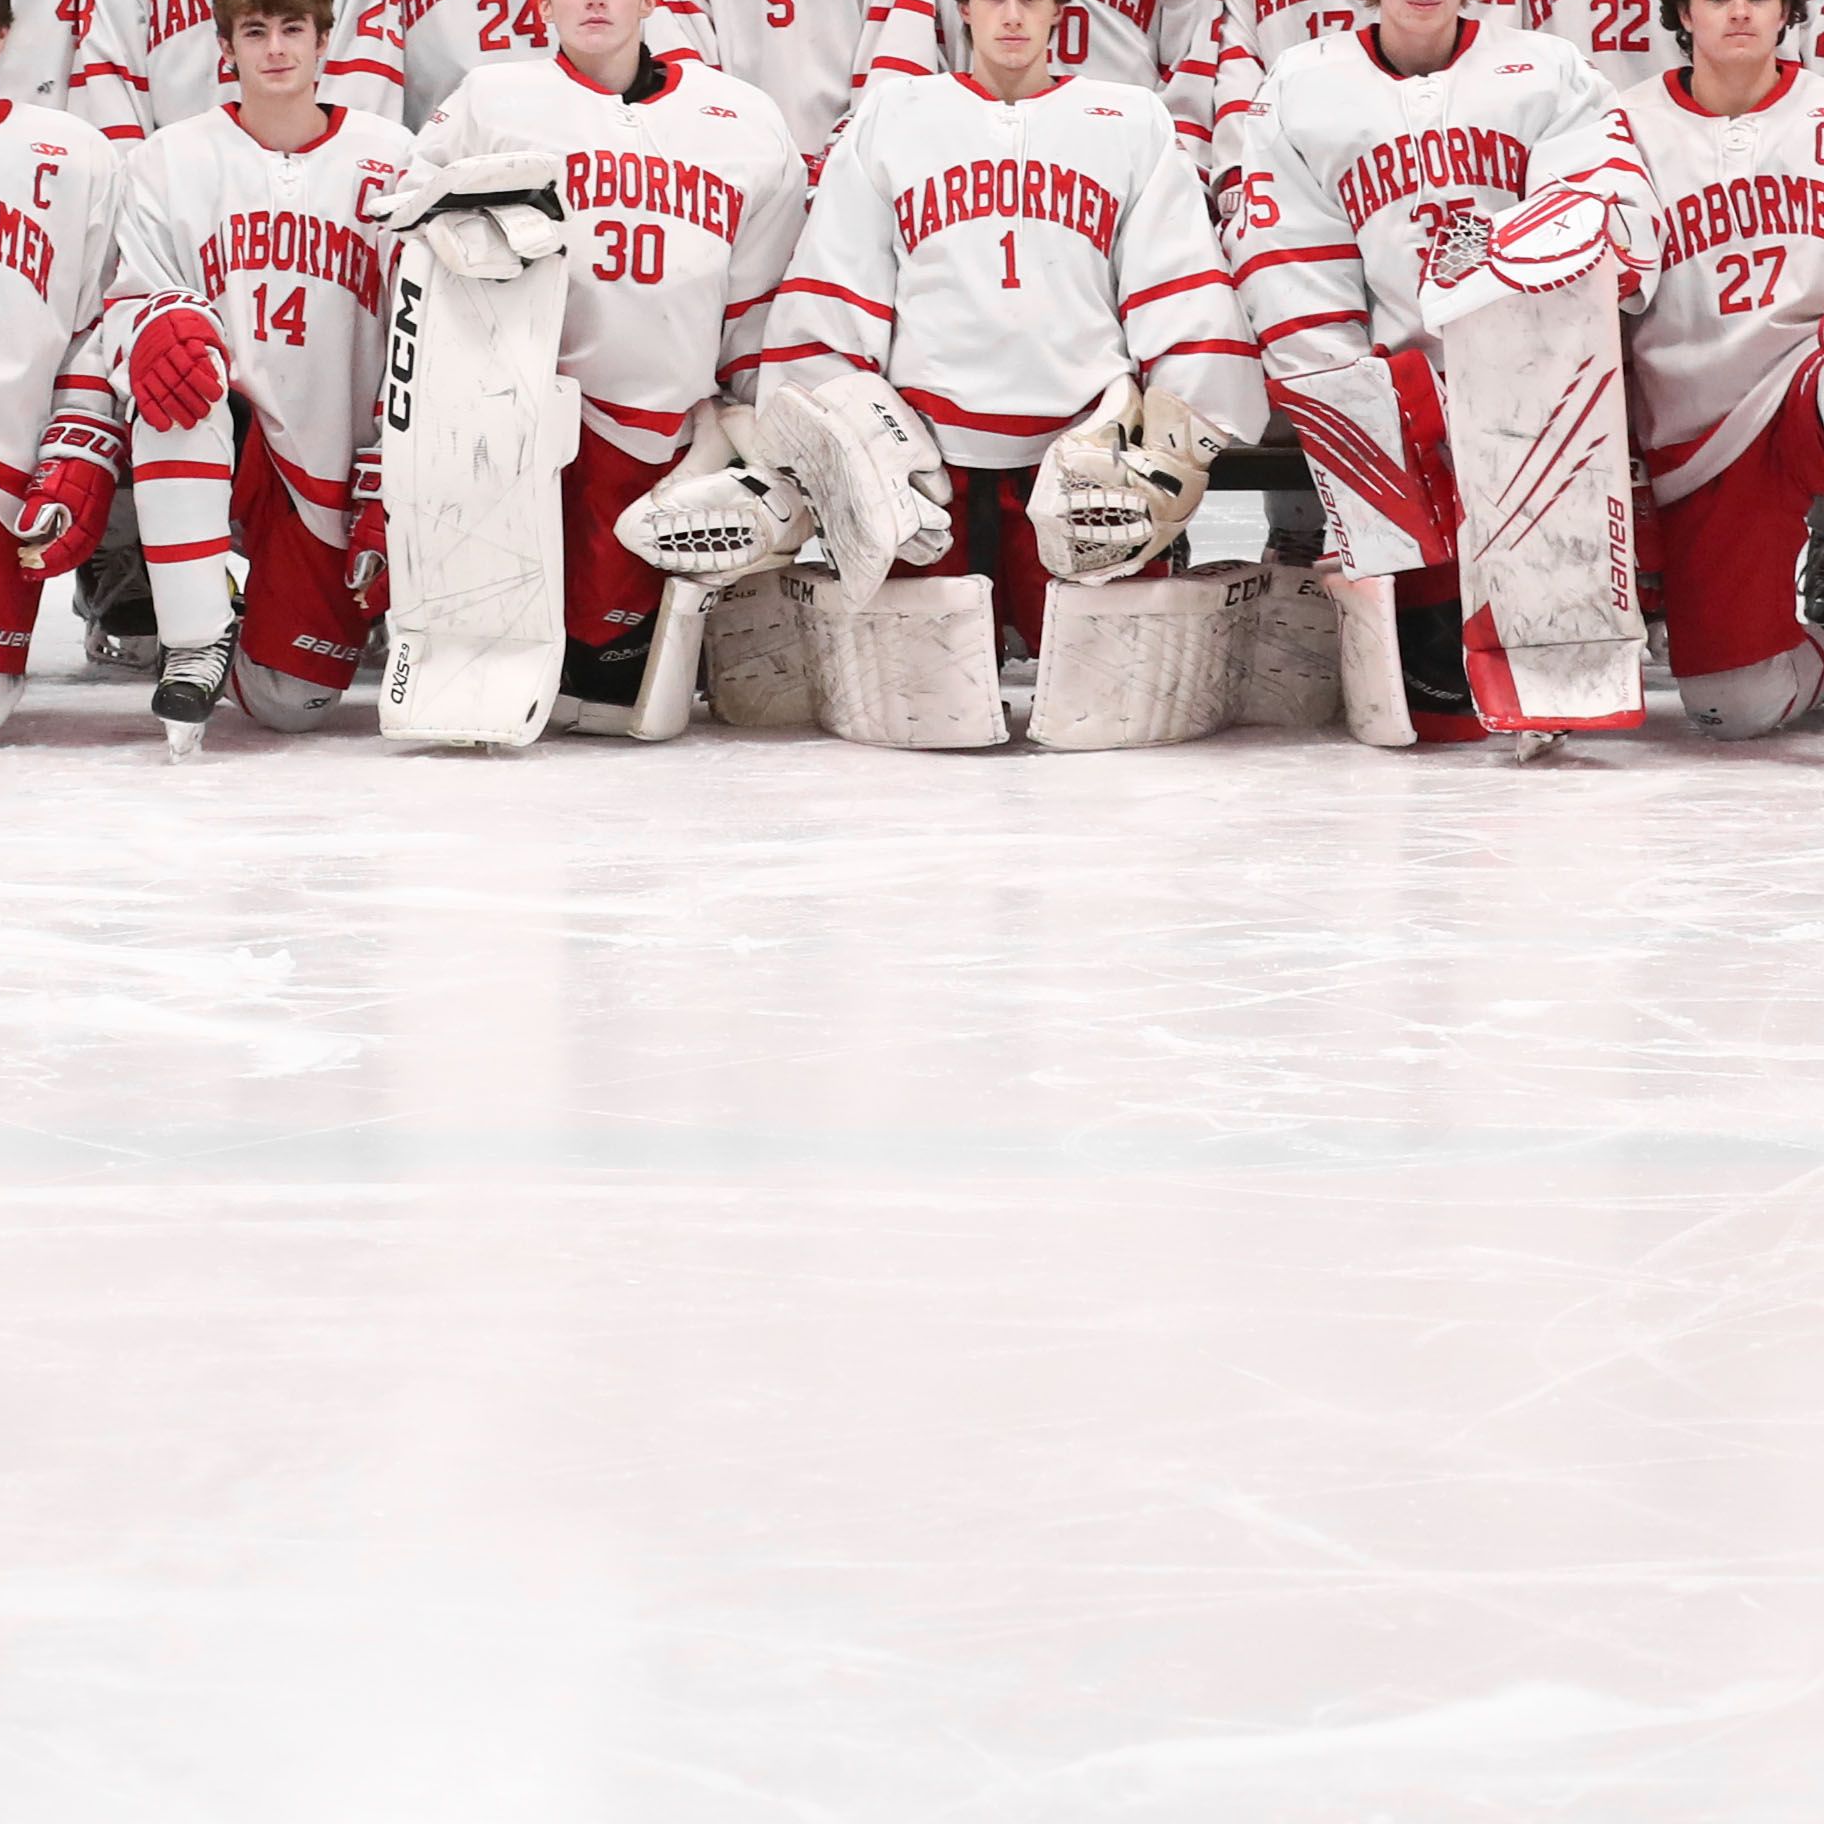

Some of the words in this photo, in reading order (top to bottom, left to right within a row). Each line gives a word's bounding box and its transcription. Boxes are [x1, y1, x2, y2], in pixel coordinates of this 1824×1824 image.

[33, 163, 58, 209] C
[567, 150, 744, 246] RBORMEN
[894, 159, 1122, 258] HARBORMEN
[594, 220, 664, 284] 30
[1002, 231, 1020, 288] 1
[1717, 246, 1787, 314] 27
[255, 284, 305, 345] 14
[388, 277, 423, 433] CCM
[779, 575, 815, 606] CCM
[1224, 575, 1272, 607] CCM
